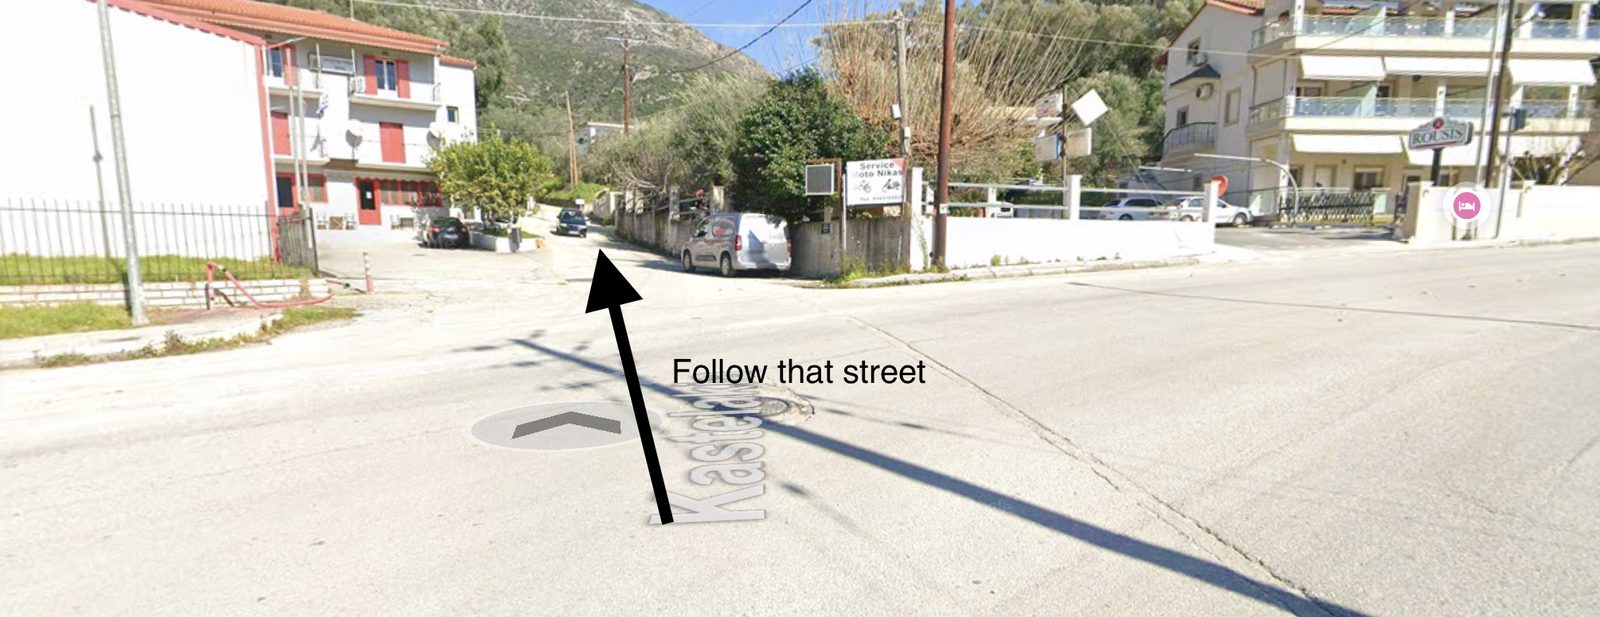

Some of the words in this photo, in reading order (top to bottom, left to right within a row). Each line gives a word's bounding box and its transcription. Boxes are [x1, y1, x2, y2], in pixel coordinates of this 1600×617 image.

[1412, 129, 1463, 144] ROUSIS
[860, 162, 895, 170] Service
[852, 170, 875, 178] oto
[877, 169, 904, 177] Nikas
